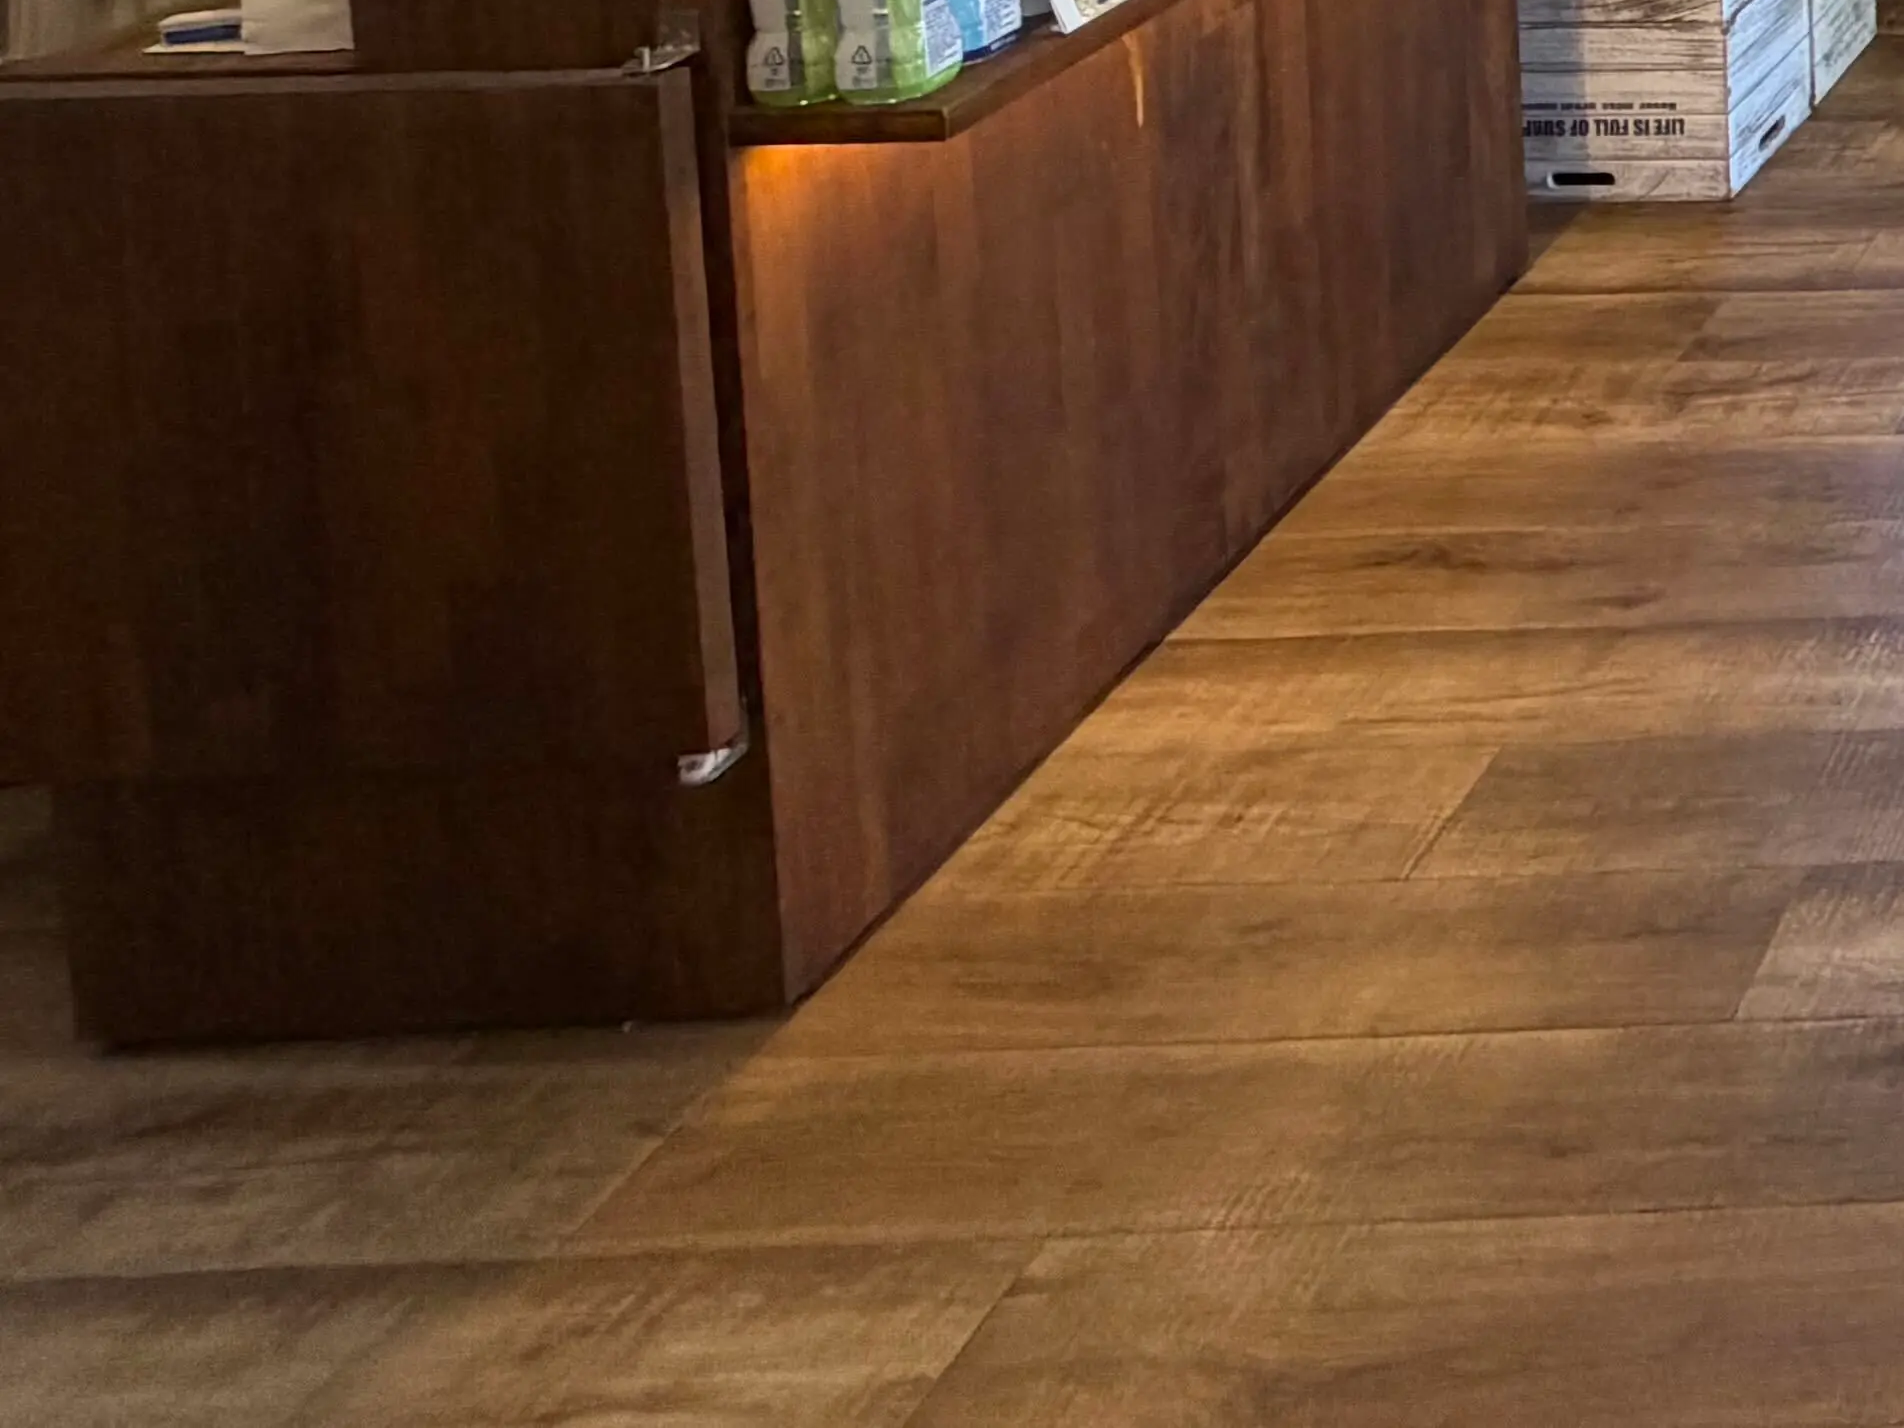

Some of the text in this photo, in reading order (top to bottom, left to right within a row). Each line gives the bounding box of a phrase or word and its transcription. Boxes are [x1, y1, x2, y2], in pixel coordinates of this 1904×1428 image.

[1570, 119, 1589, 137] OF
[1593, 119, 1629, 137] FULL
[1633, 119, 1650, 137] IS
[1653, 119, 1685, 137] LIFE
